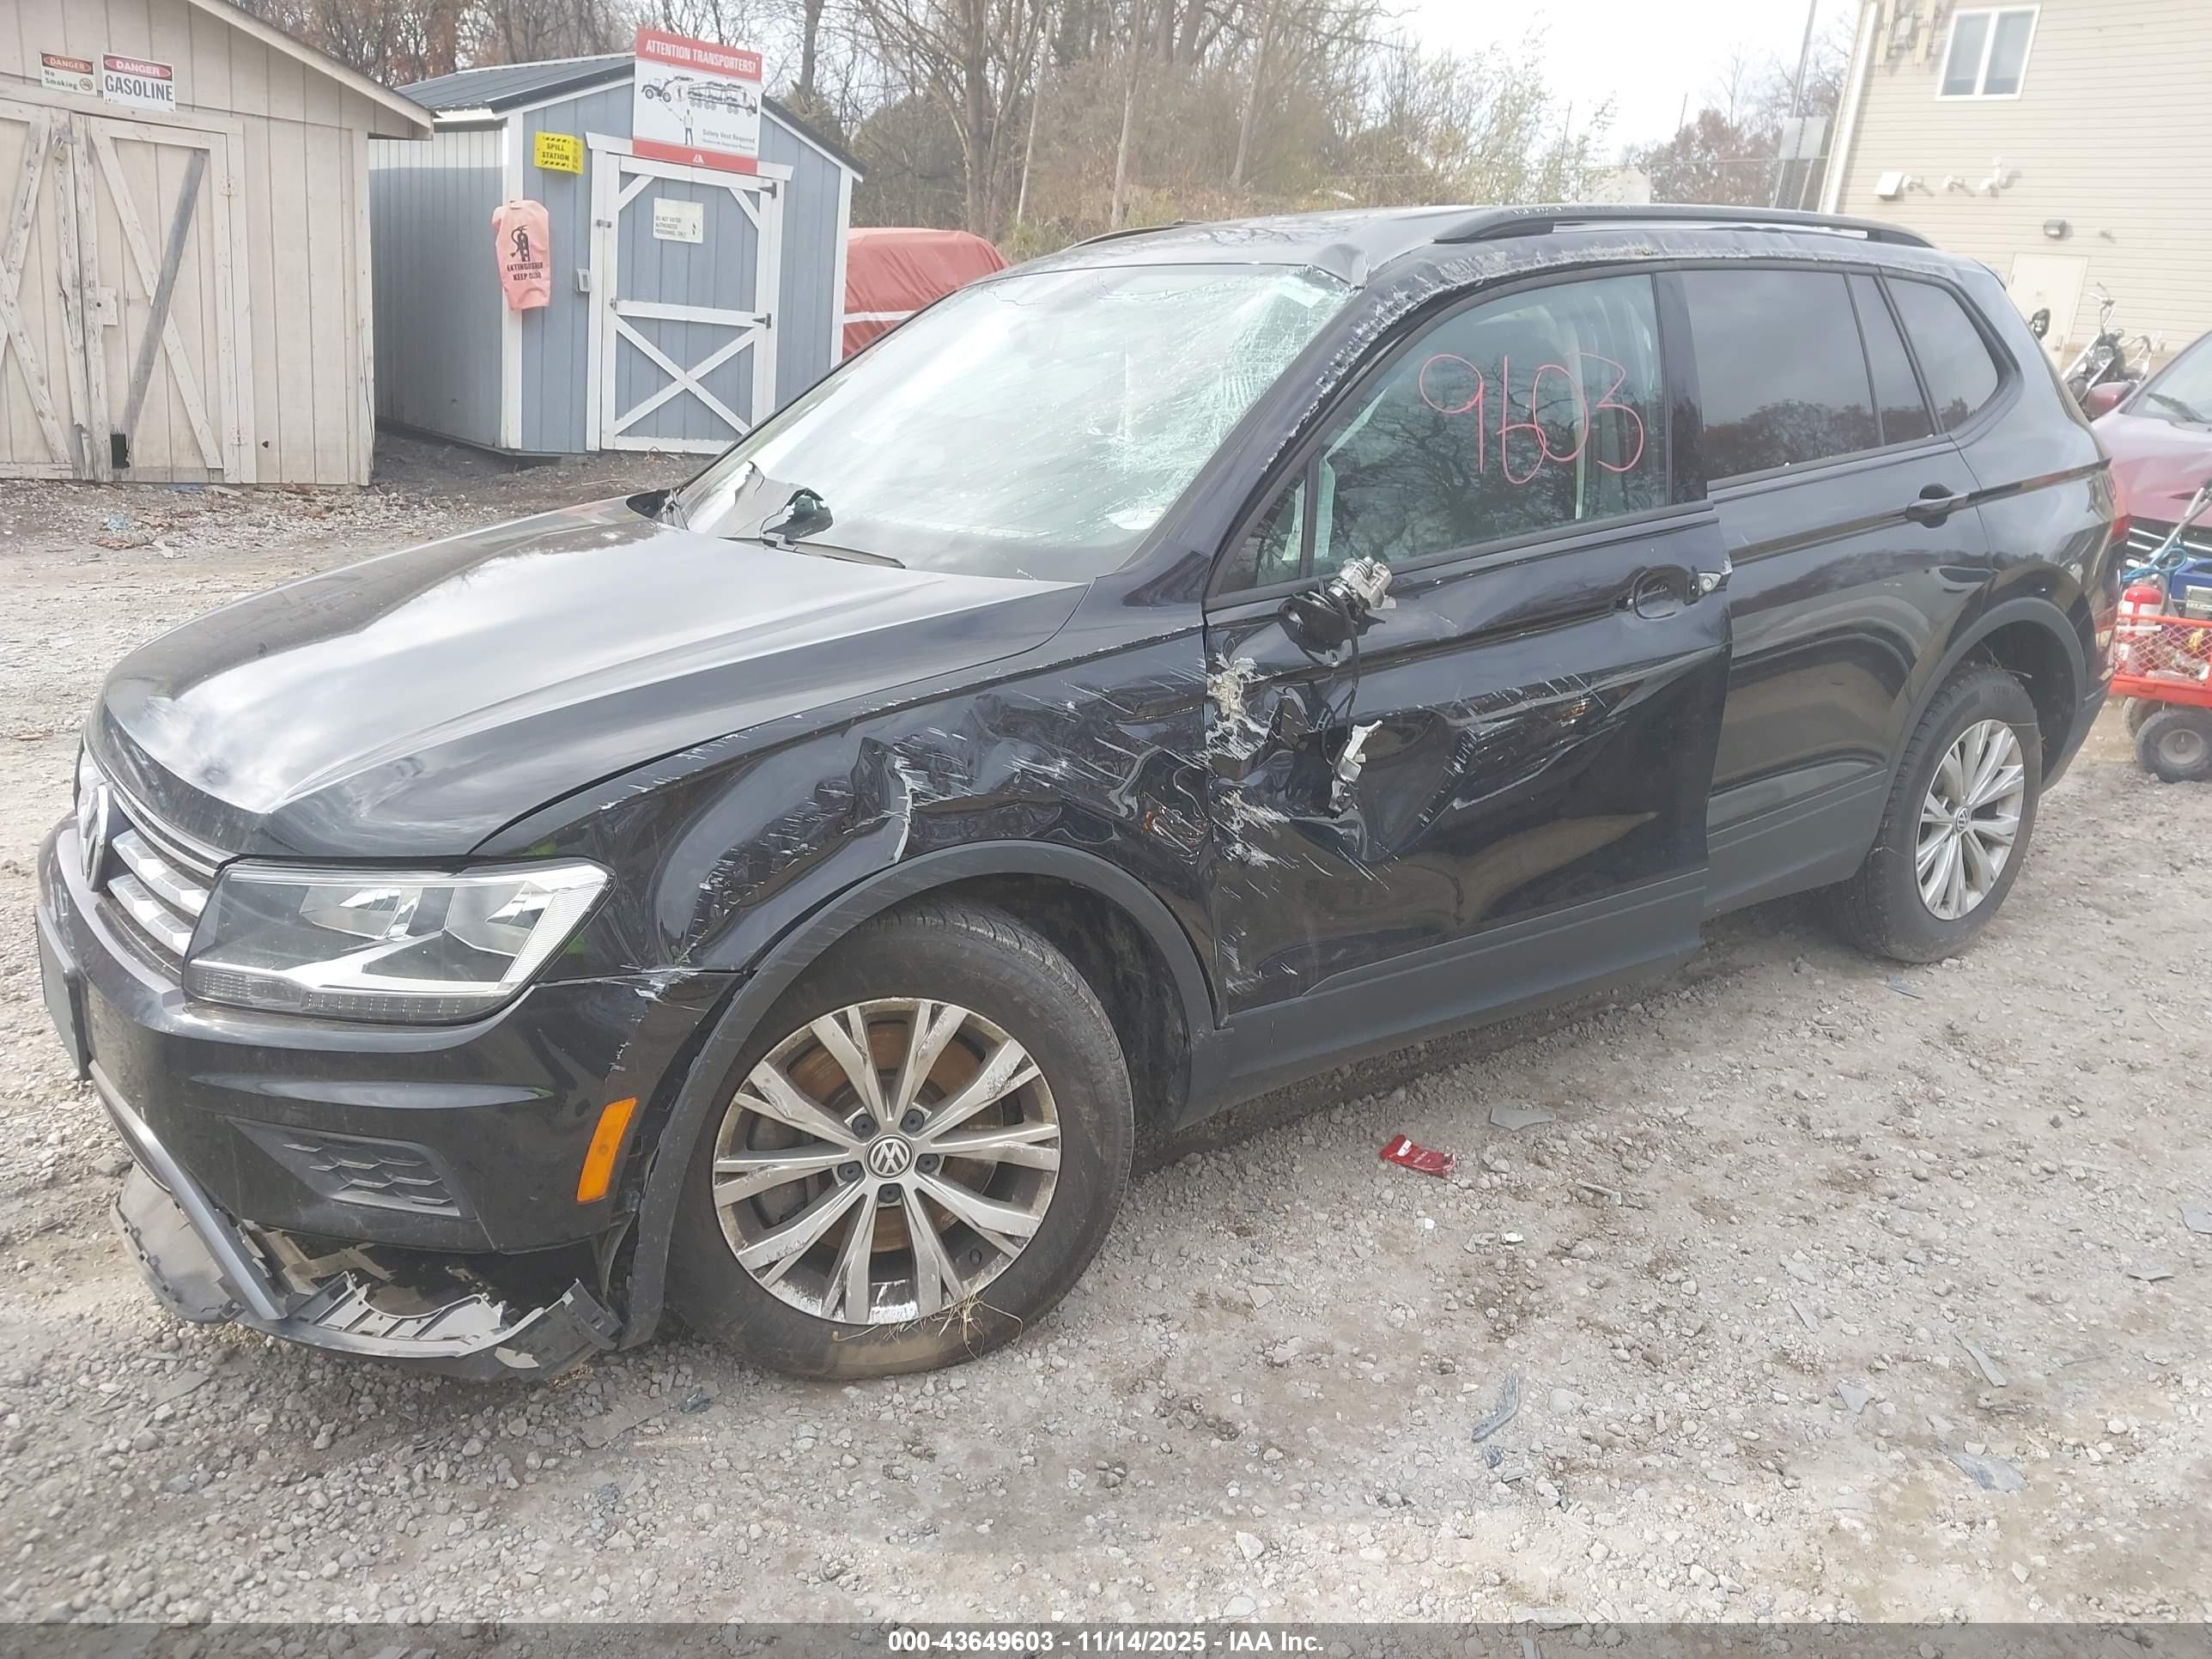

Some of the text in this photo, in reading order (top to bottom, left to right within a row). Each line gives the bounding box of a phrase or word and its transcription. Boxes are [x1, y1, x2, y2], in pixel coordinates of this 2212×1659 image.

[50, 57, 84, 72] DANGER
[646, 39, 756, 74] ATTENTION TRANSPORTERS!
[116, 60, 160, 76] DANGER
[105, 75, 173, 102] GASOLINE
[546, 143, 565, 151] SPILL
[542, 151, 569, 161] STATION
[1419, 351, 1644, 484] 9603
